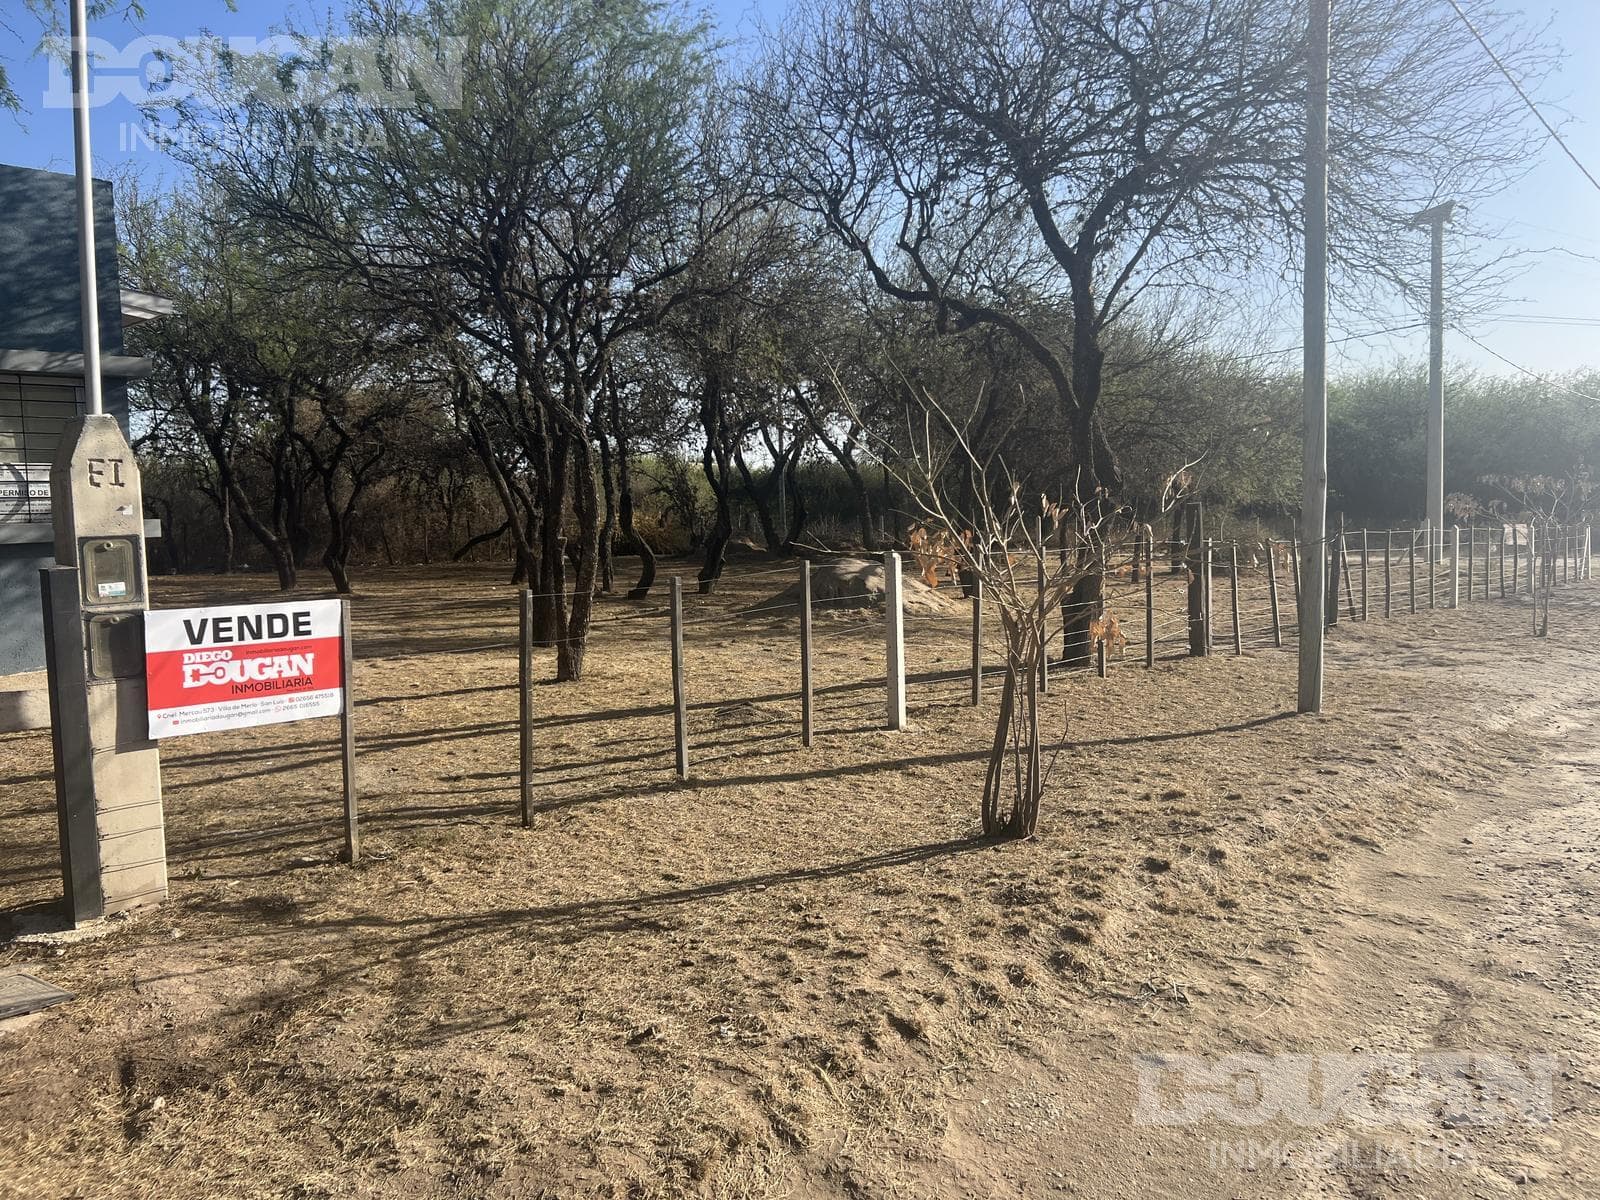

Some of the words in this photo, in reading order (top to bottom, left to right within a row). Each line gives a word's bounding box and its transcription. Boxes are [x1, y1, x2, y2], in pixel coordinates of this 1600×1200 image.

[37, 489, 49, 497] DE
[182, 611, 313, 646] VENDE
[182, 649, 233, 664] DIEGO
[182, 653, 315, 688] DOUGAN
[231, 677, 313, 695] INMOBILIARIA
